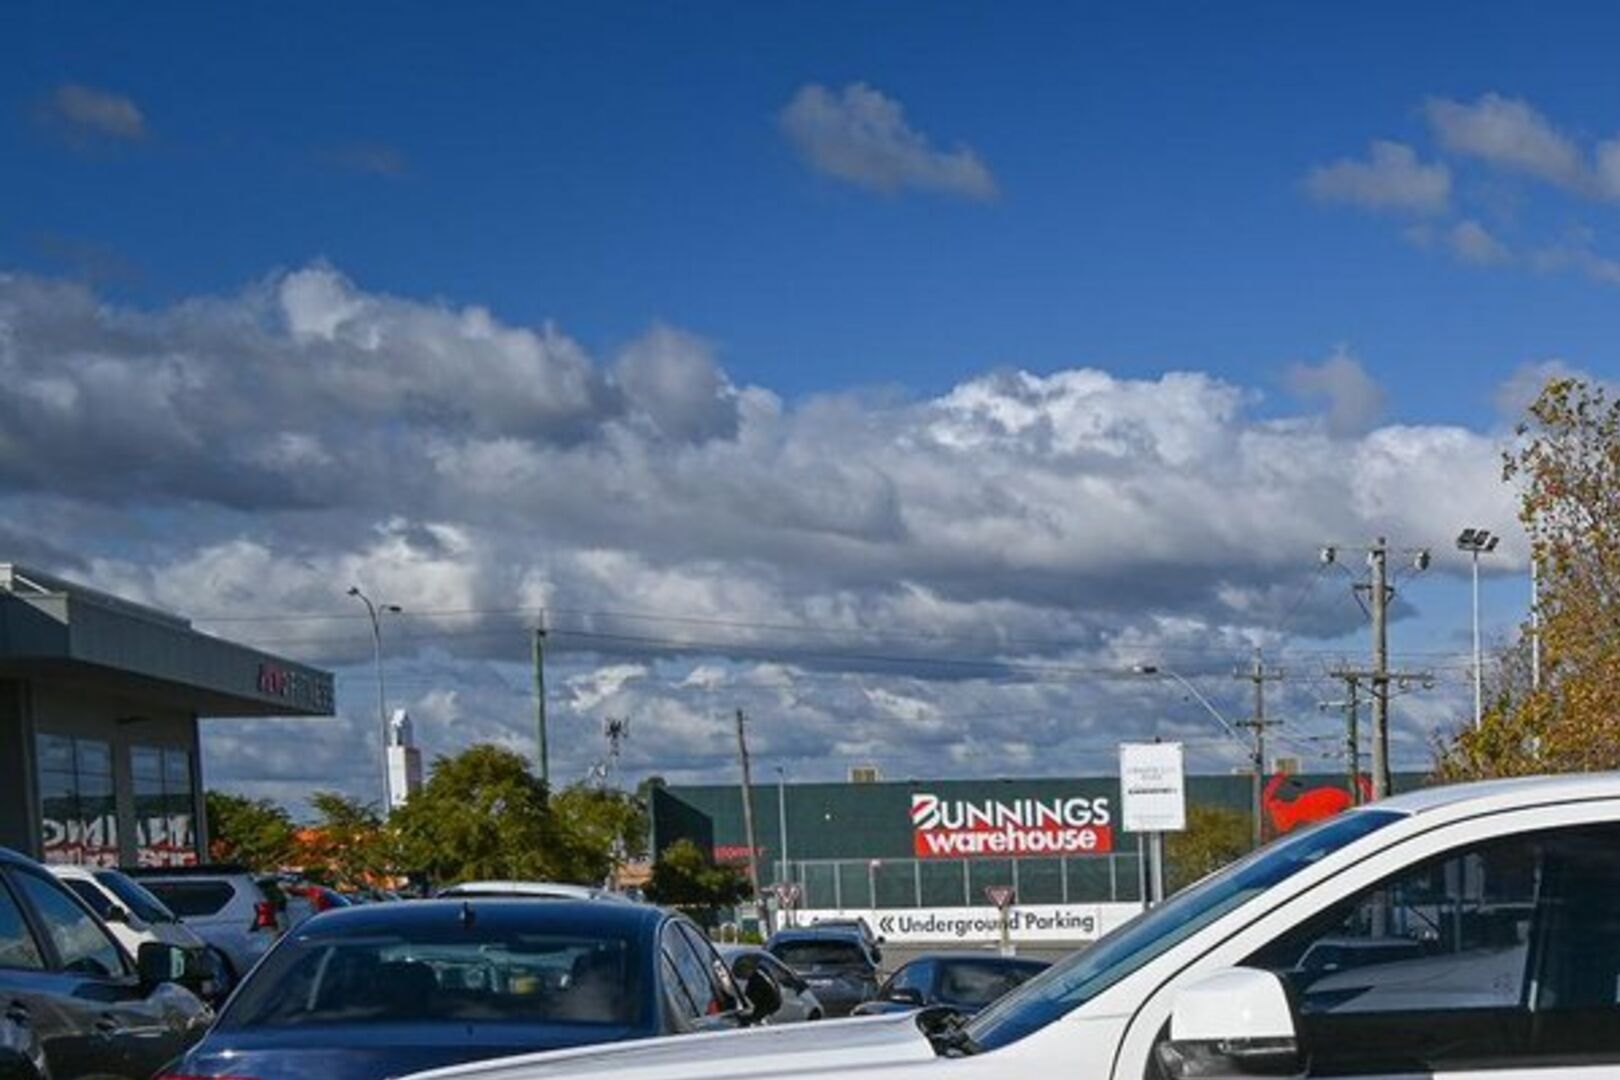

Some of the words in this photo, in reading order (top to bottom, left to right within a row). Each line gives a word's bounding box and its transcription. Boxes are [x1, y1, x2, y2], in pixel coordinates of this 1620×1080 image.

[911, 794, 1110, 829] BUNNINGS
[925, 822, 1097, 853] warehouse
[899, 911, 1019, 936] Underground
[1025, 911, 1094, 932] Parking
